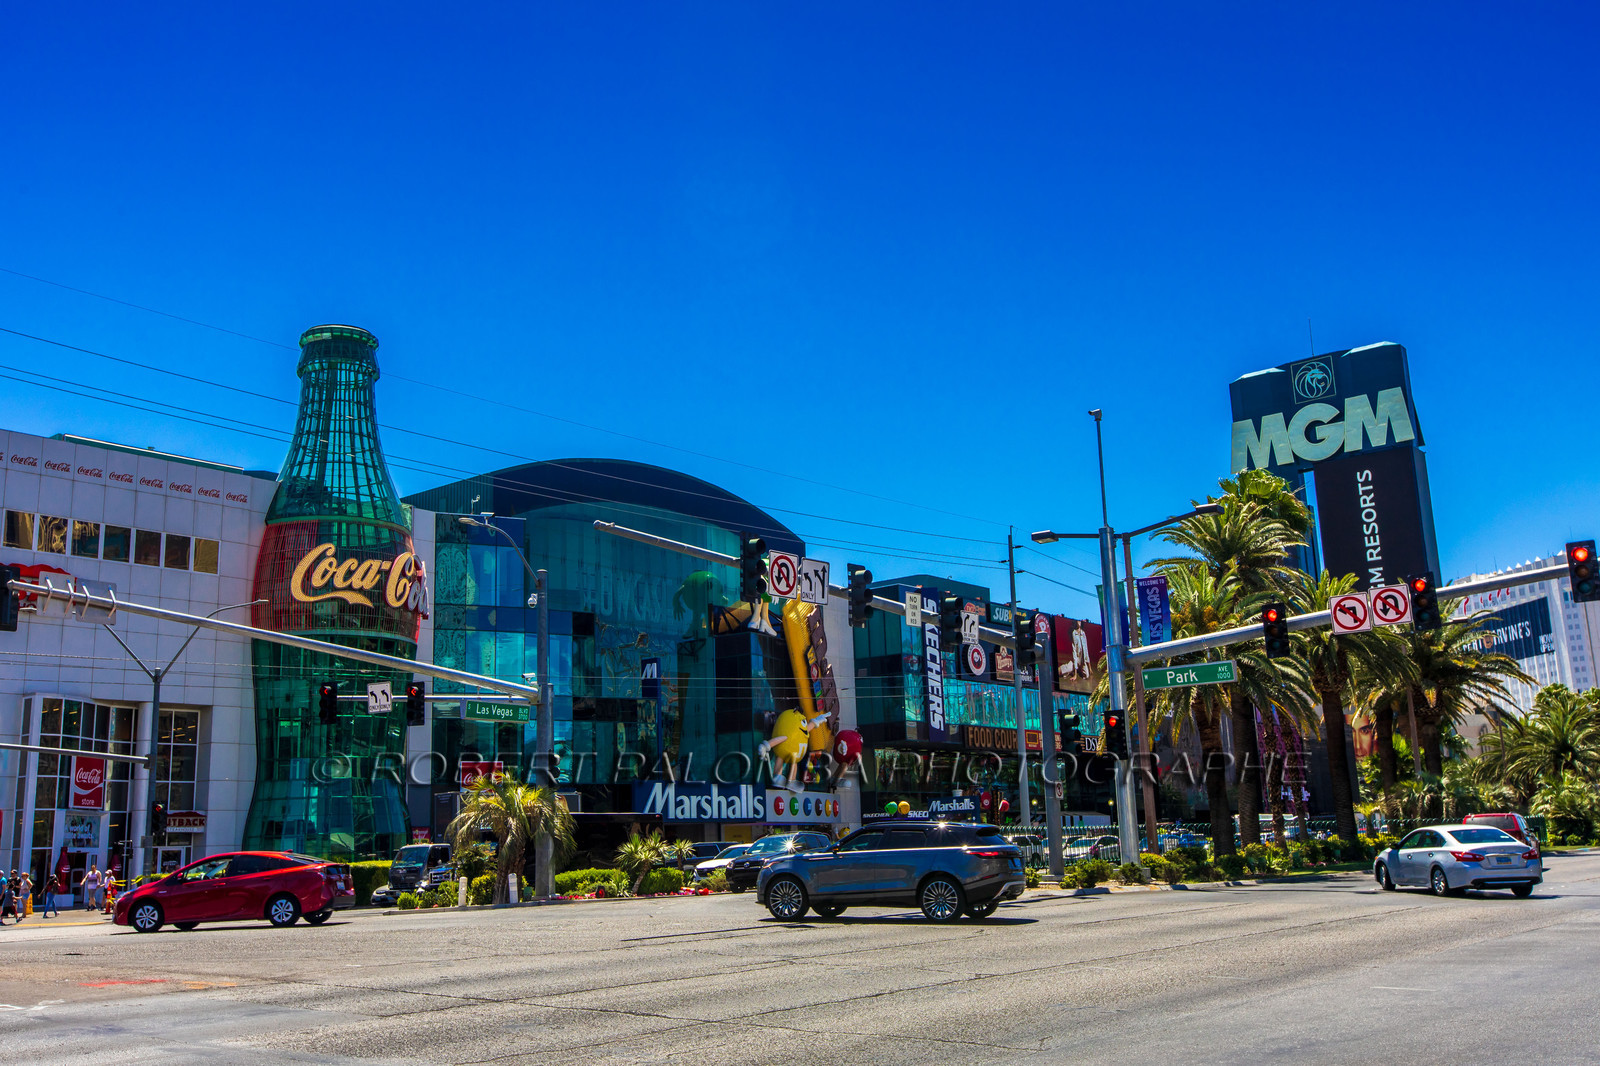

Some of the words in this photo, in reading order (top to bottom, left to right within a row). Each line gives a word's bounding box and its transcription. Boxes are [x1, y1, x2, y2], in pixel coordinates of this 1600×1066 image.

[1231, 386, 1415, 474] MGM
[1357, 469, 1382, 561] RESORTS
[802, 591, 814, 600] ONLY
[1146, 586, 1162, 622] VEGAS
[1150, 622, 1163, 644] LAS
[1492, 621, 1530, 645] IRVINE'S
[1539, 633, 1553, 645] NOW
[923, 598, 945, 731] SKECHERS
[1167, 669, 1198, 684] Park
[476, 704, 489, 714] Las
[492, 705, 513, 718] Vegas
[968, 727, 992, 748] FOOD
[995, 729, 1018, 749] COUR
[644, 782, 764, 820] Marshalls
[929, 799, 975, 812] Marshalls
